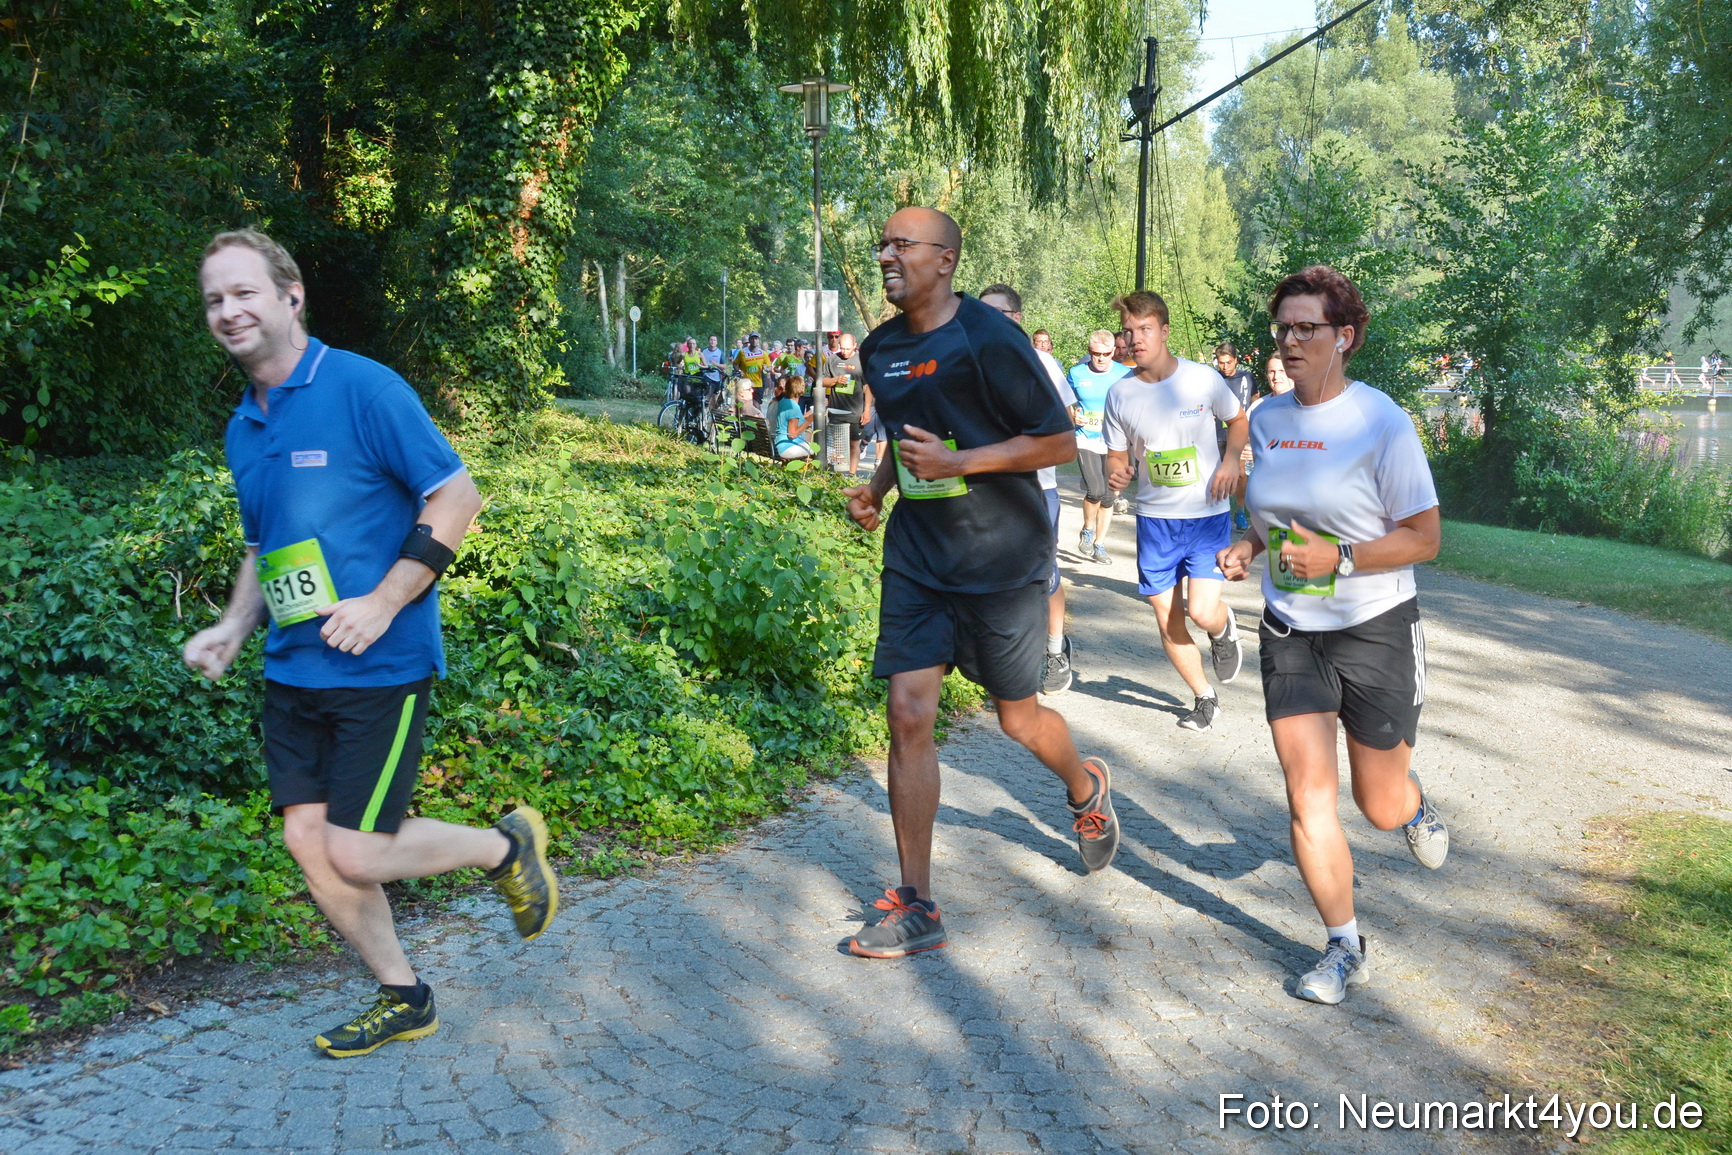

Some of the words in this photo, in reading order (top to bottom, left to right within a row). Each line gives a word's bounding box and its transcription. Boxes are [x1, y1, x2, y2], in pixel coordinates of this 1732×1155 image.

[1180, 408, 1199, 416] reindl
[1280, 440, 1328, 451] KLEBL
[1153, 461, 1190, 476] 1721
[266, 570, 316, 607] 1518
